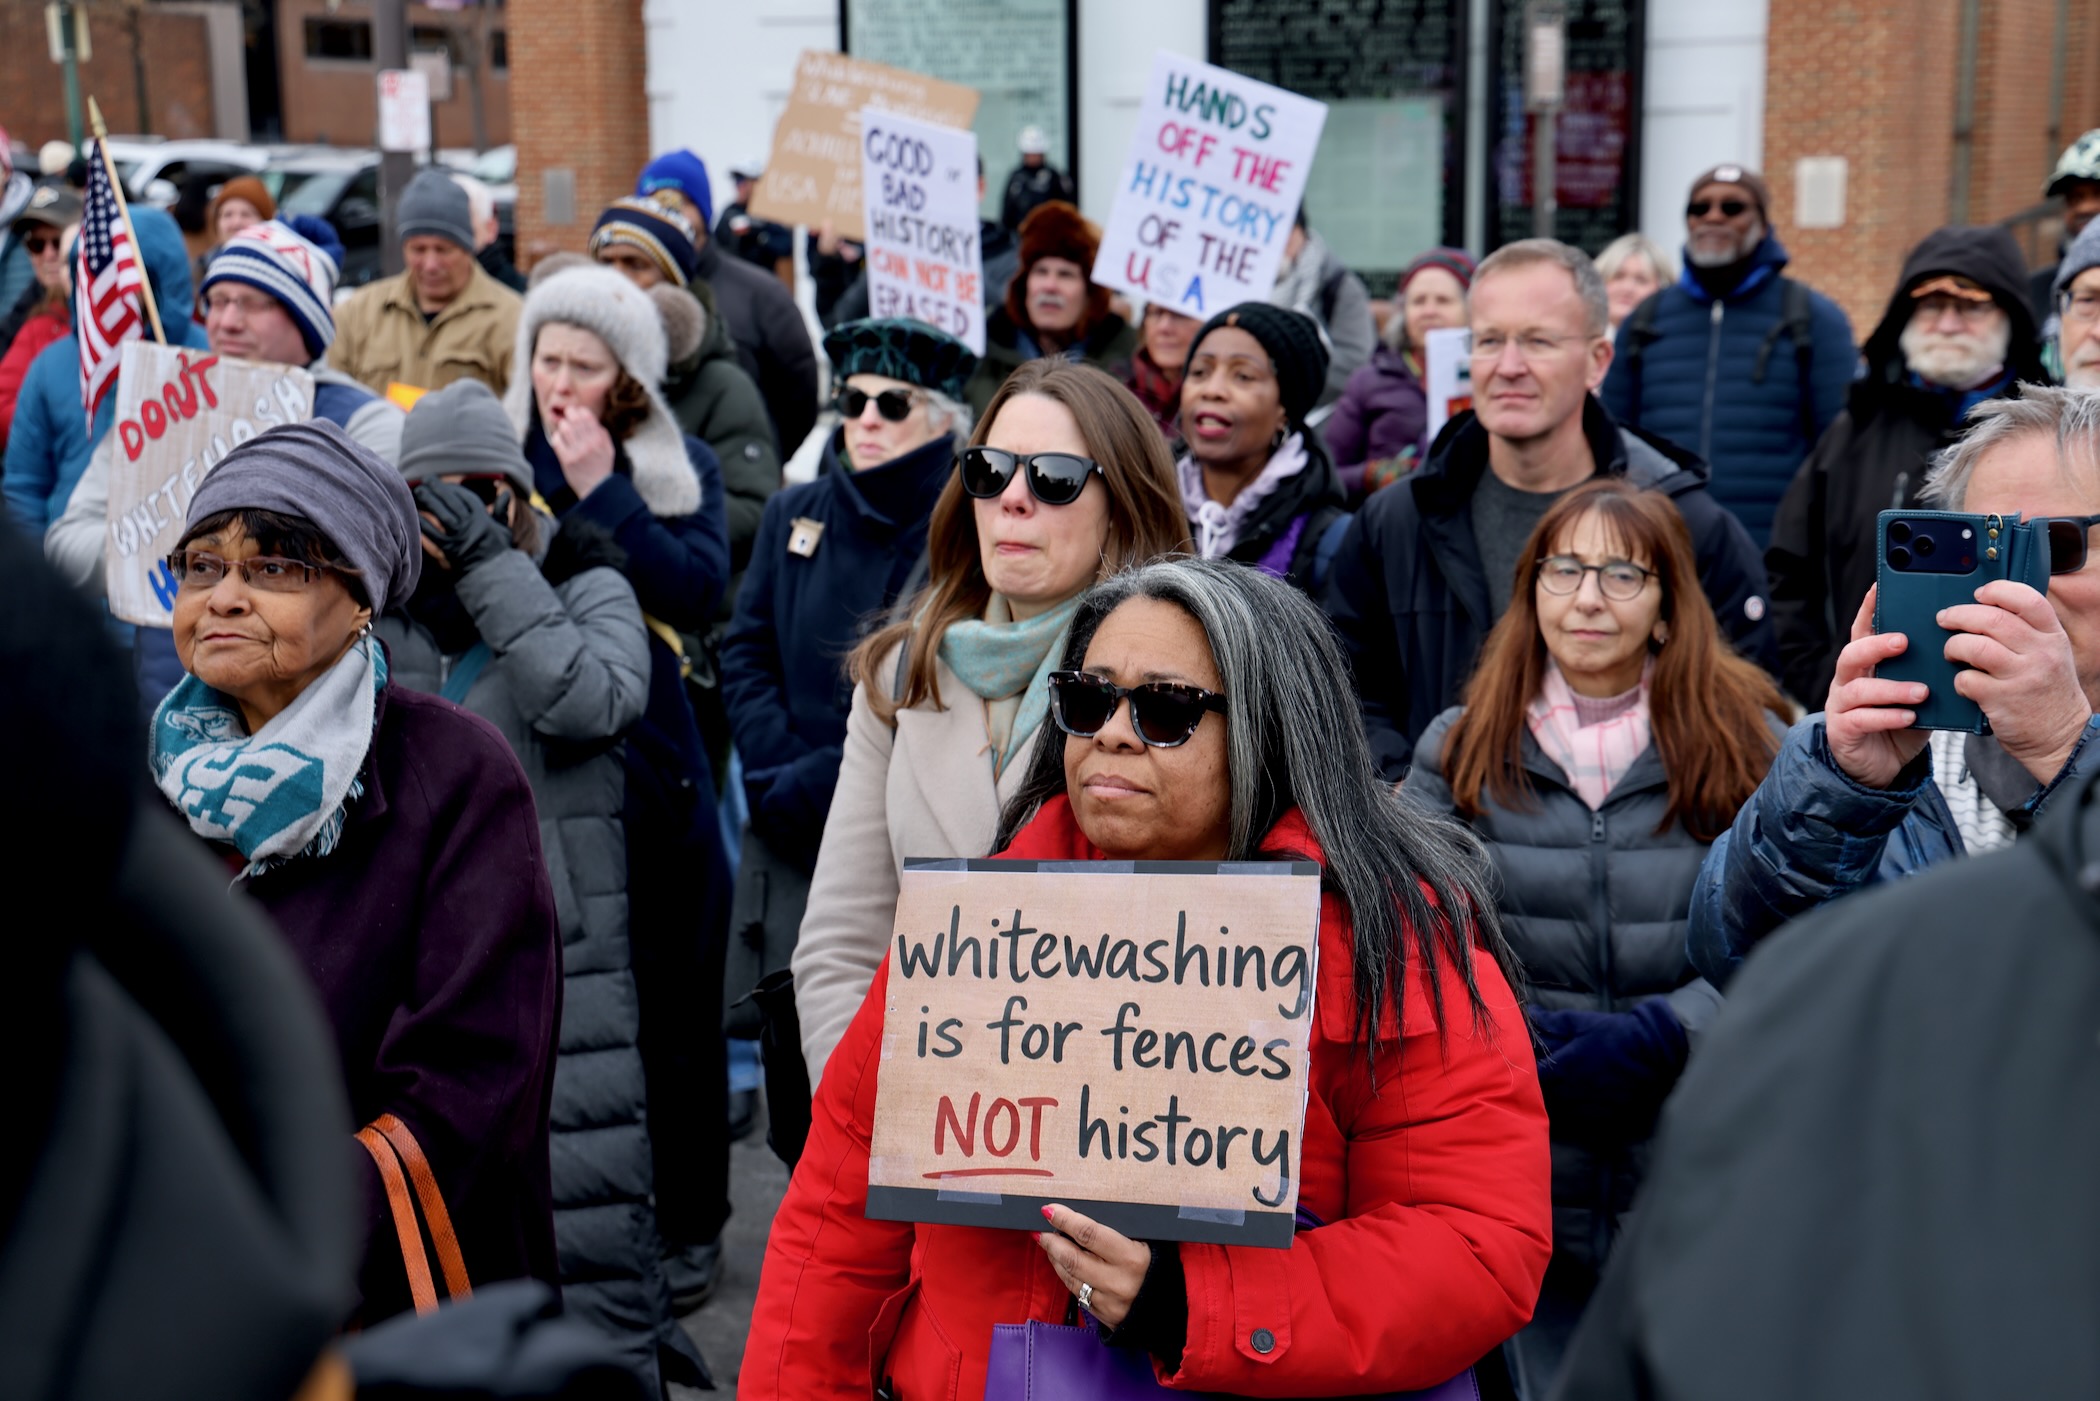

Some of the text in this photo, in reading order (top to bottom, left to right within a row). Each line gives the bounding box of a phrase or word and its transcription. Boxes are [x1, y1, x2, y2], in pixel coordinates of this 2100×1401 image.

[1163, 71, 1276, 140] HANDS
[865, 126, 933, 177] GOOD
[1157, 121, 1293, 195] OFF THE
[882, 172, 926, 213] BAD
[1129, 160, 1284, 246] HISTORY
[871, 206, 974, 268] HISTORY
[1137, 213, 1259, 286] OF THE
[914, 257, 949, 296] NOT
[119, 352, 220, 463] DON'T
[898, 905, 1309, 1019] whitewashing
[917, 995, 1292, 1080] is for fences
[934, 1084, 1289, 1207] NOT history
